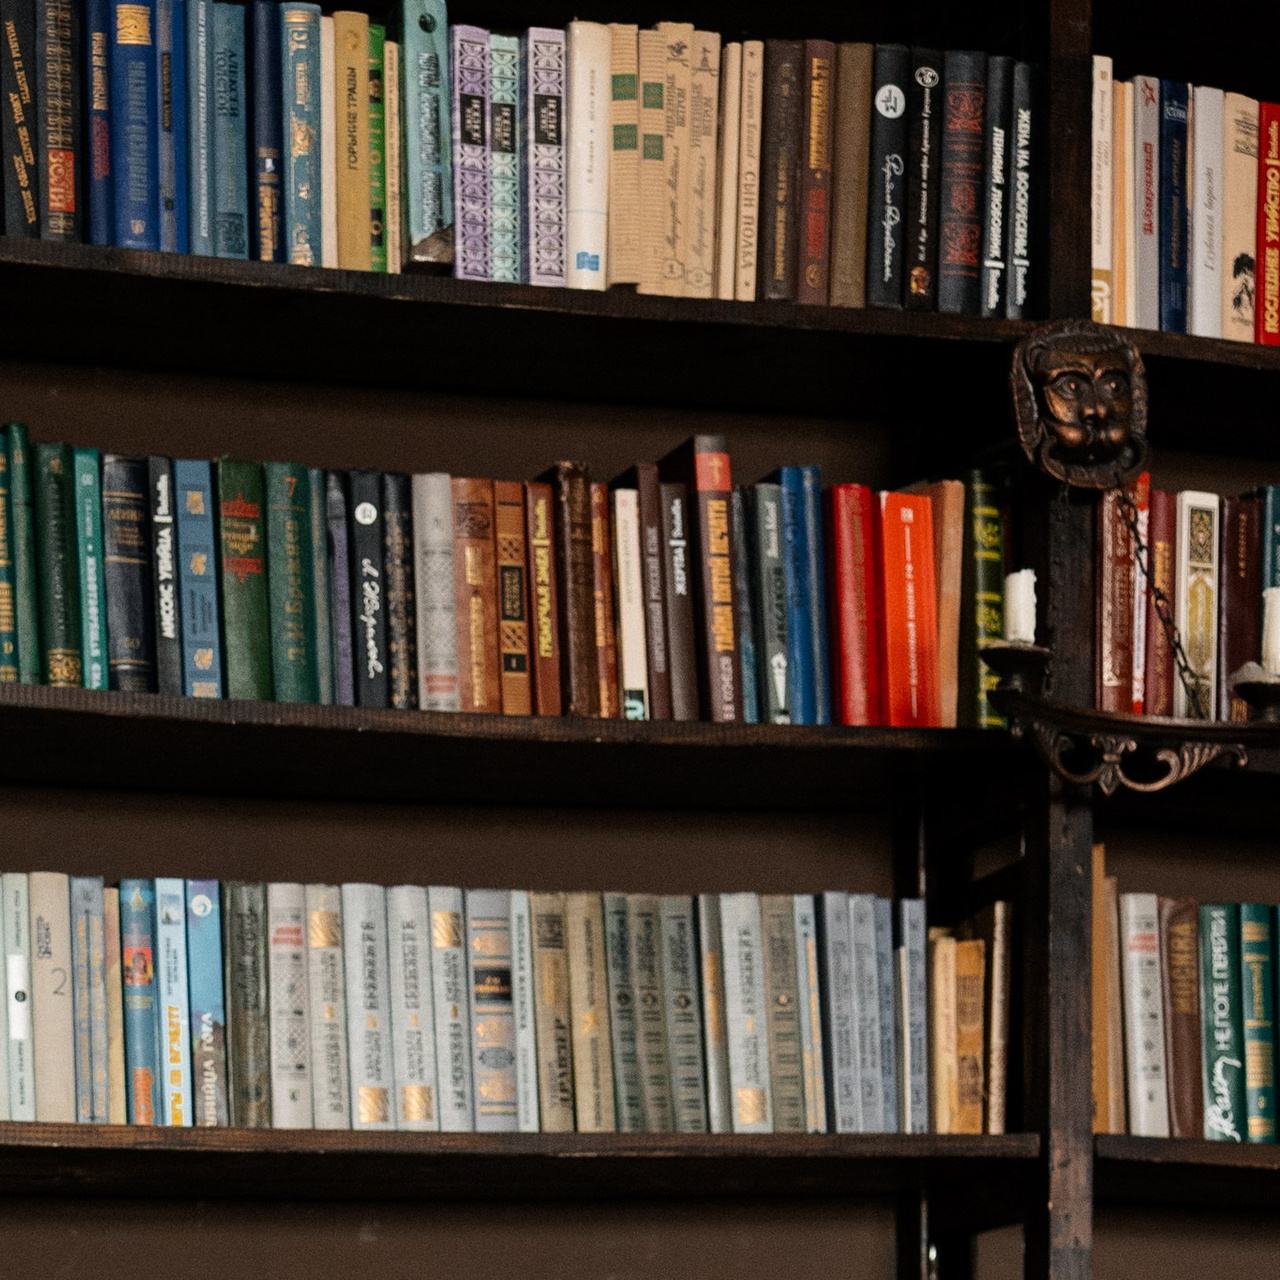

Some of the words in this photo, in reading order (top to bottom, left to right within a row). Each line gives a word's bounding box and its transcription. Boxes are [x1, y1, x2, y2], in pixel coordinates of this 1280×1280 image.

[346, 66, 358, 108] ТРАВЫ
[743, 171, 757, 209] СЫН
[1264, 168, 1280, 242] УБИЙСТВО
[740, 214, 756, 271] ПОЛКА
[156, 527, 172, 580] УБИЙЦА
[160, 583, 175, 638] МИССИС
